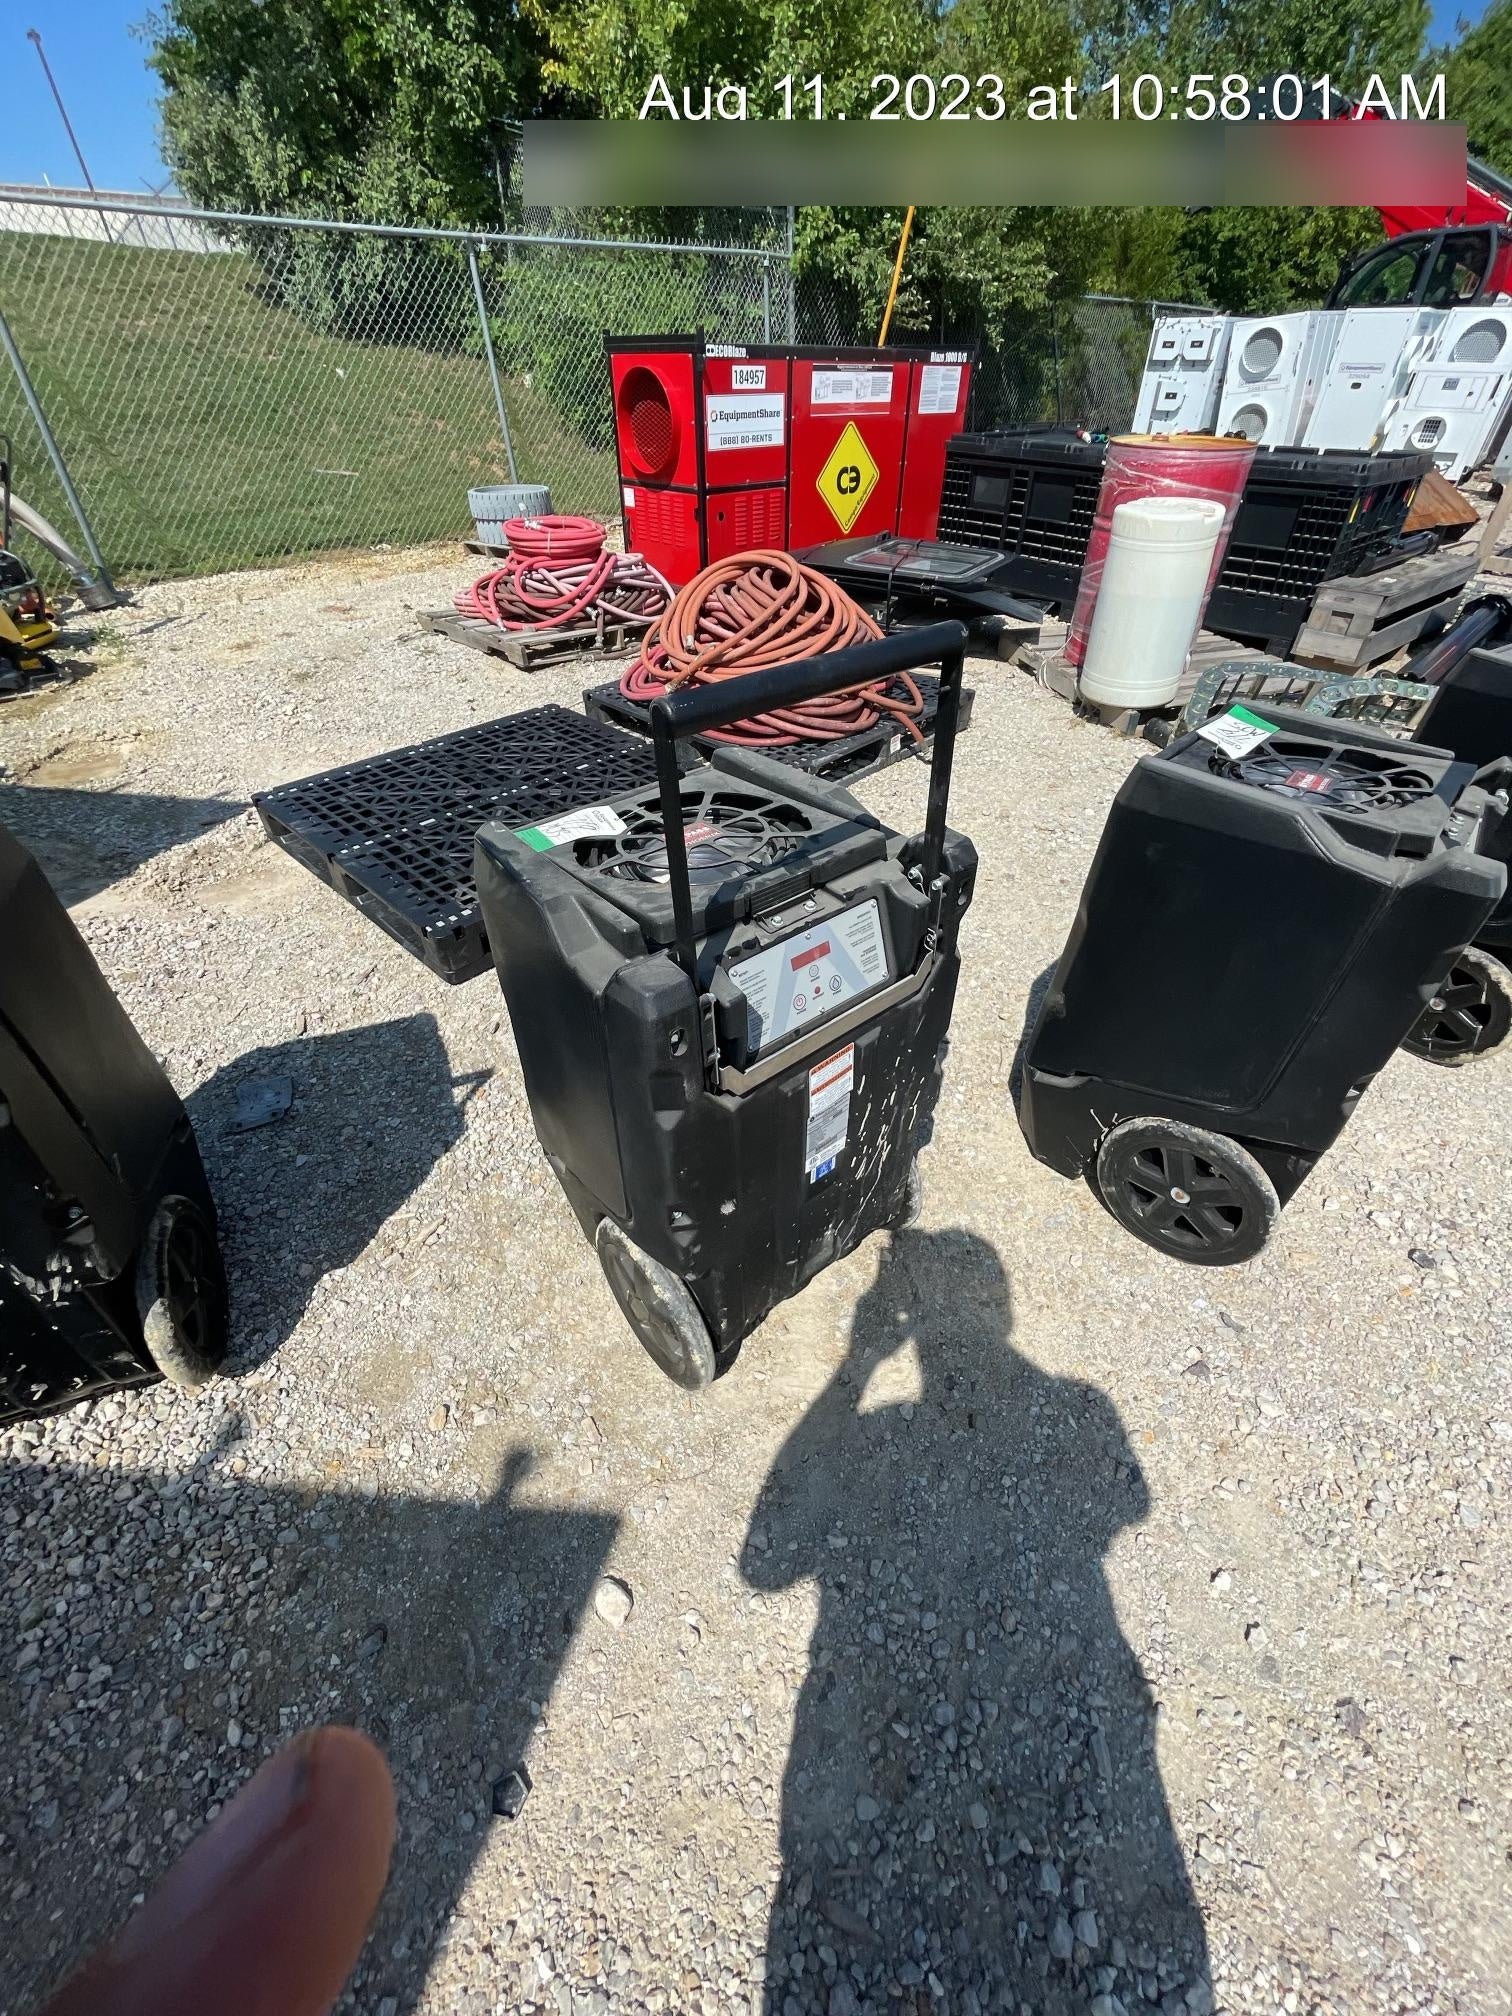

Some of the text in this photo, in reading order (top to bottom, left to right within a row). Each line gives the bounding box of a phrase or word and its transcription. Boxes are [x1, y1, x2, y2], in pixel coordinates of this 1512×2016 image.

[734, 369, 765, 385] 184957
[719, 408, 781, 422] EquipmentShare
[720, 433, 773, 446] (888) 80-RENTS
